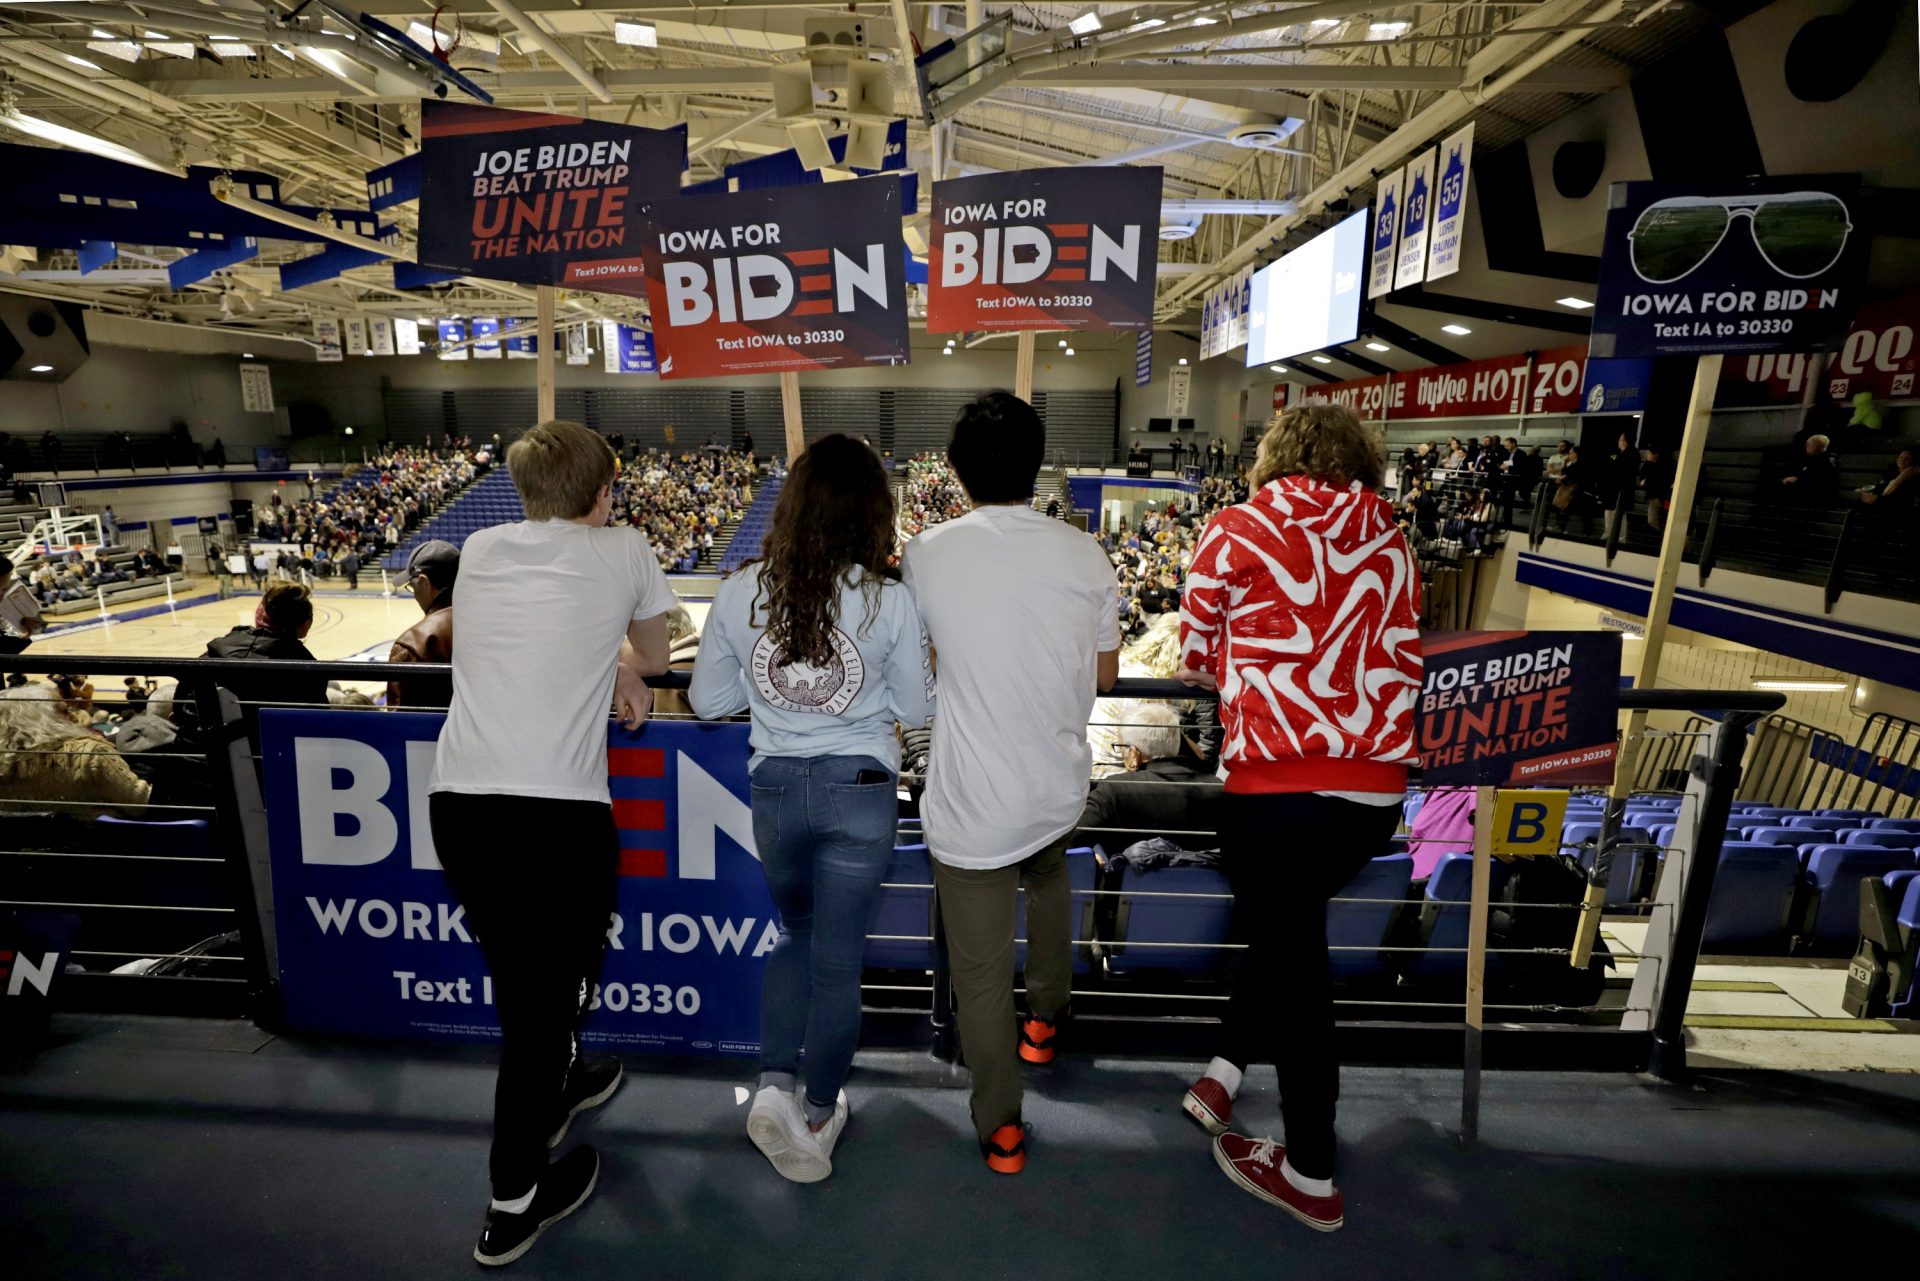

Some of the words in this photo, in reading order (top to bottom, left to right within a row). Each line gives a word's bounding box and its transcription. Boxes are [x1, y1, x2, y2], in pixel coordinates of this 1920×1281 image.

[473, 148, 531, 176] JOE
[536, 139, 631, 170] BIDEN
[473, 172, 536, 196] BEAT
[543, 165, 629, 190] TRUMP
[1442, 172, 1461, 206] 55
[472, 186, 629, 239] UNITE
[945, 202, 998, 226] IOWA
[1003, 199, 1046, 219] FOR
[1410, 194, 1424, 223] 13
[659, 229, 727, 254] IOWA
[731, 223, 780, 247] FOR
[1379, 211, 1393, 238] 33
[1439, 220, 1456, 237] LORRI
[471, 236, 521, 260] THE
[526, 227, 625, 255] NATION
[942, 224, 1141, 288] BIDEN
[1406, 238, 1418, 251] JAN
[1433, 235, 1458, 255] BAUMAN
[575, 268, 595, 277] Text
[596, 265, 626, 276] IOWA
[628, 264, 638, 273] to
[1400, 252, 1421, 267] JENSEN
[663, 244, 888, 327] BIDEN
[976, 298, 999, 308] Text
[1003, 296, 1036, 307] IOWA
[1039, 296, 1051, 306] to
[1054, 296, 1092, 307] 30330
[1622, 294, 1693, 316] IOWA
[1700, 291, 1757, 313] FOR
[1763, 289, 1839, 311] BIDEN
[716, 337, 744, 350] Text
[748, 334, 785, 347] IOWA
[788, 333, 801, 344] to
[804, 330, 844, 344] 30330
[1654, 323, 1689, 338] Text
[1694, 322, 1712, 336] IA
[1716, 322, 1735, 336] to
[1738, 319, 1793, 335] 30330
[1361, 382, 1406, 411] ZONE
[1417, 374, 1468, 412] HyVee
[1472, 366, 1528, 403] HOT
[1832, 384, 1846, 394] 23
[1894, 379, 1912, 390] 24
[1602, 617, 1642, 634] RESTROOMS
[754, 644, 770, 684] IVORY
[846, 658, 860, 684] ELLA
[1422, 663, 1478, 695] JOE
[1484, 644, 1573, 682] BIDEN
[1422, 684, 1484, 713] BEAT
[1491, 666, 1571, 699] TRUMP
[1421, 686, 1572, 750] UNITE
[1423, 744, 1466, 770] THE
[1473, 723, 1568, 760] NATION
[1520, 765, 1540, 774] Text
[1541, 760, 1570, 771] IOWA
[1570, 756, 1581, 764] to
[1583, 749, 1612, 762] 30330
[294, 736, 763, 880] BIEN
[1506, 802, 1548, 844] B
[305, 896, 481, 943] WORK
[393, 971, 472, 1004] Text
[1854, 968, 1866, 980] 13
